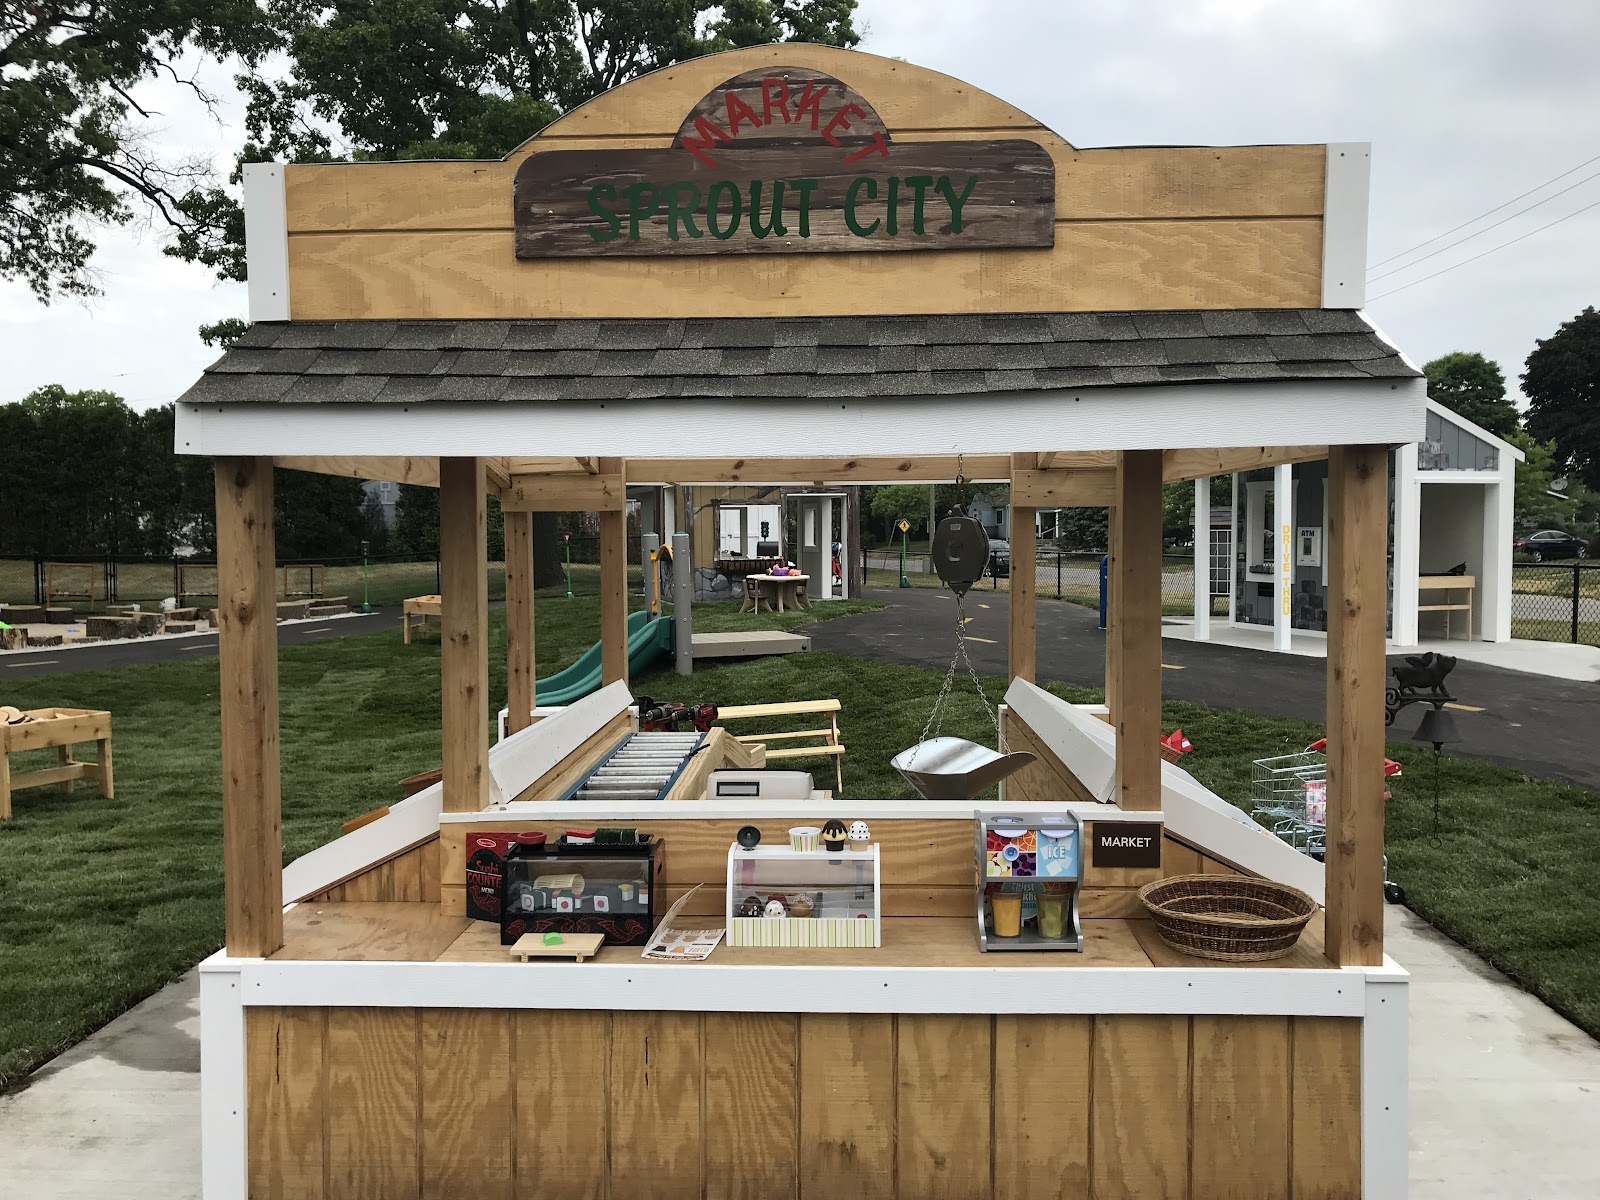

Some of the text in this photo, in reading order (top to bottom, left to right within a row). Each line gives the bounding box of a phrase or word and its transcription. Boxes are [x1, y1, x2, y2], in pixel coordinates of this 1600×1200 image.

[681, 77, 889, 169] MARKET
[587, 174, 979, 242] SPROUT CITY
[1283, 525, 1291, 615] DRIVE THRU
[1101, 836, 1152, 848] MARKET
[1047, 845, 1066, 860] ICE
[475, 860, 499, 874] Sushi
[467, 872, 502, 887] COUNTE
[1011, 882, 1035, 892] Thirst
